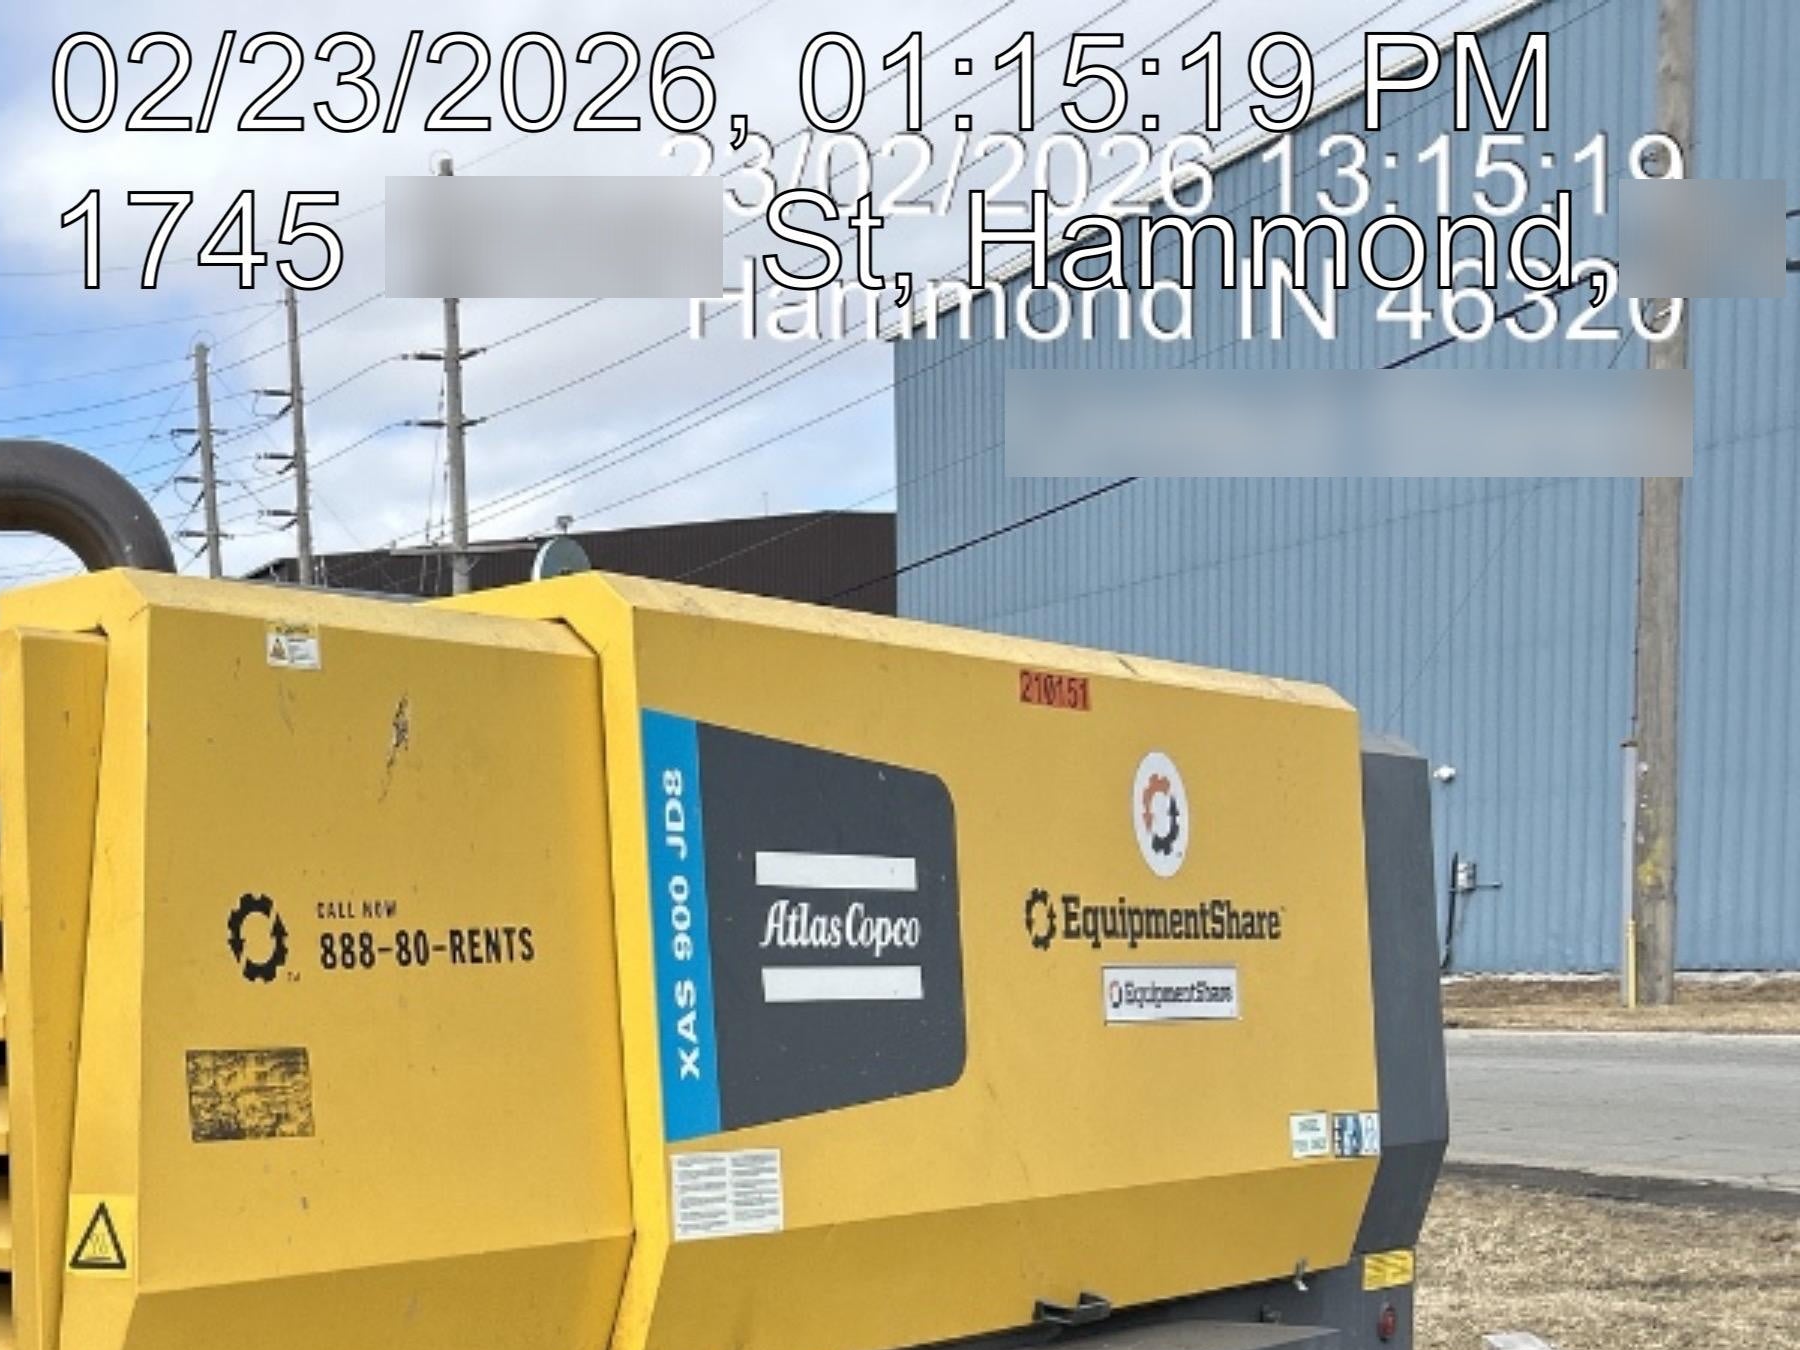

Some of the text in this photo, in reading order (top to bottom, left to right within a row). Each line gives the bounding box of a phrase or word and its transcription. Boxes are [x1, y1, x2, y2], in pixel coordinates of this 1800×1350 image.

[317, 900, 398, 919] CALL NOW
[662, 768, 700, 1081] XAS 900 JD8
[758, 899, 922, 958] Atlas Copco
[1061, 894, 1282, 949] EquipmentShare
[319, 927, 536, 970] 888-80-RENTS
[1124, 980, 1233, 1009] EquipmentShare
